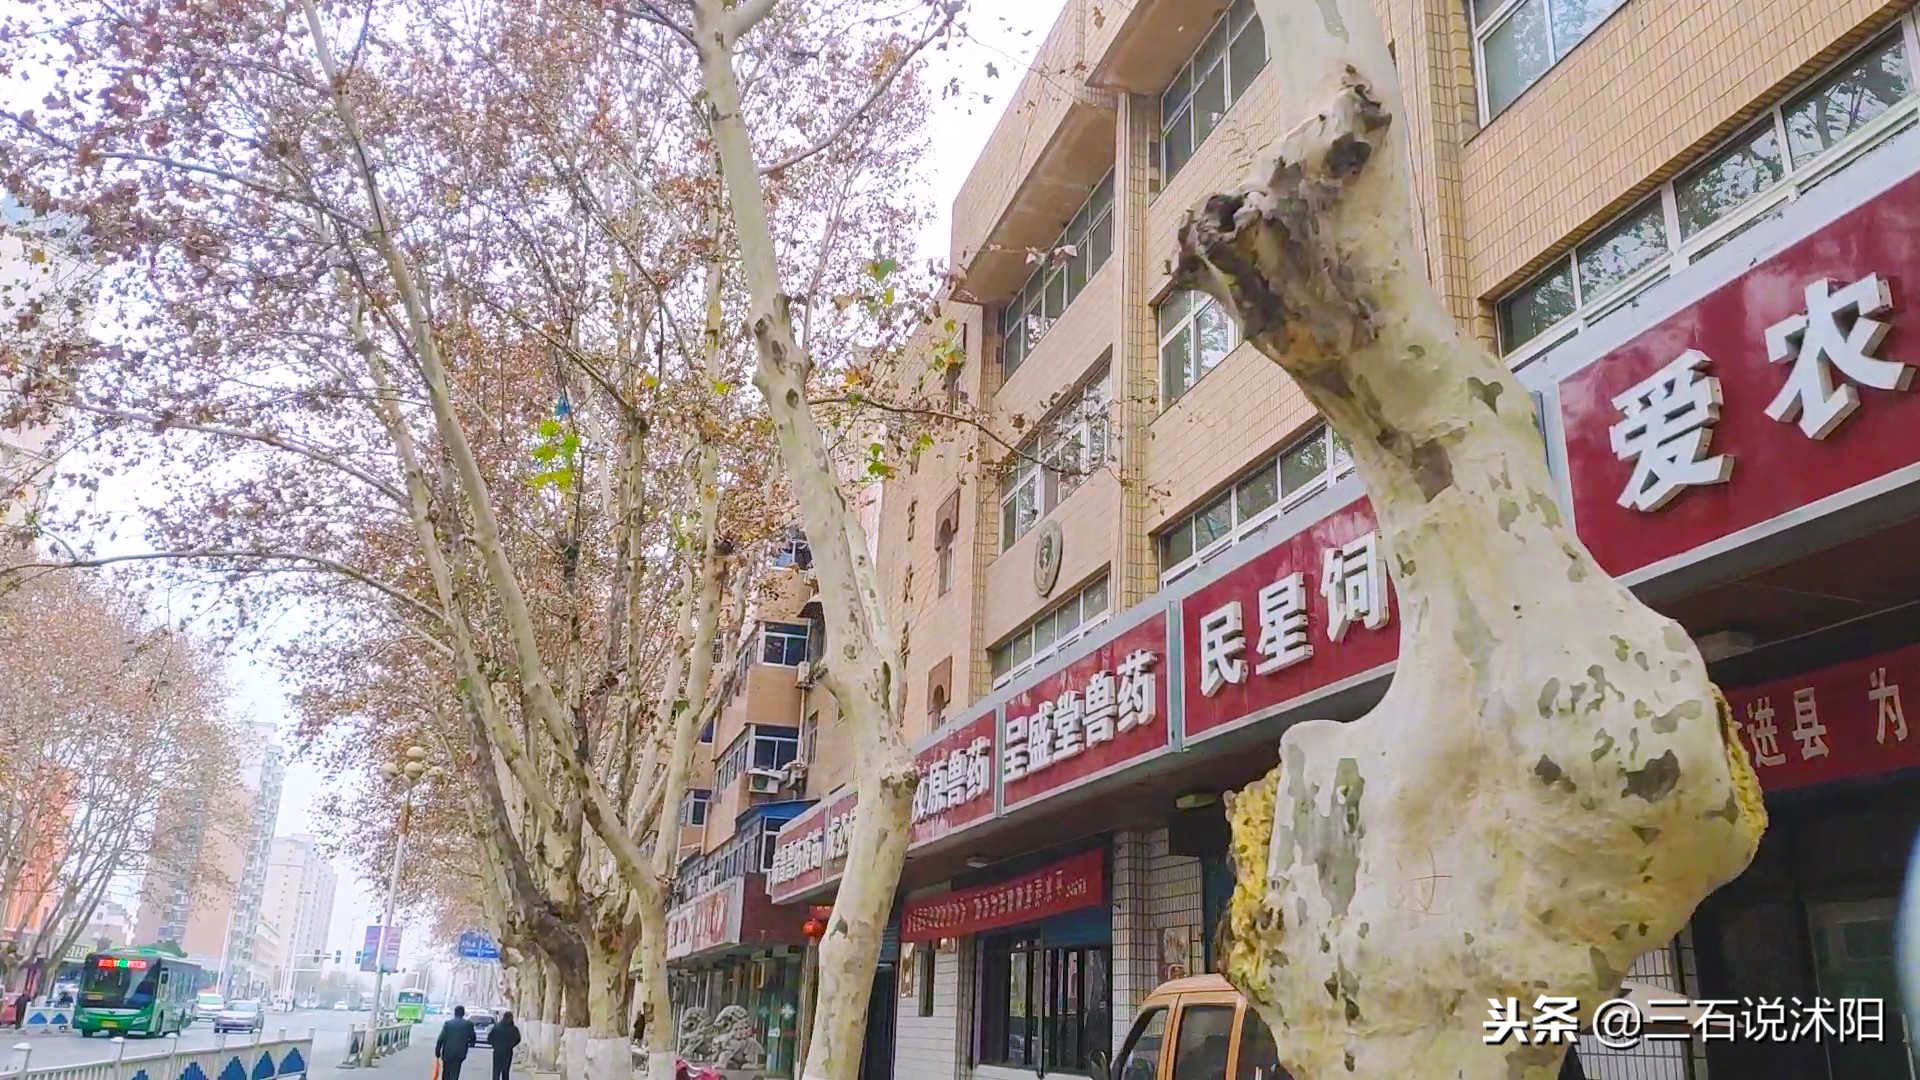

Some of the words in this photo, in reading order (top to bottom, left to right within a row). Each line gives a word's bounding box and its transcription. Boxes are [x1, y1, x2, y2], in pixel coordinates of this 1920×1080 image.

[1609, 272, 1916, 512] 爱农
[1200, 530, 1389, 697] 民星饲
[1868, 667, 1909, 745] 为
